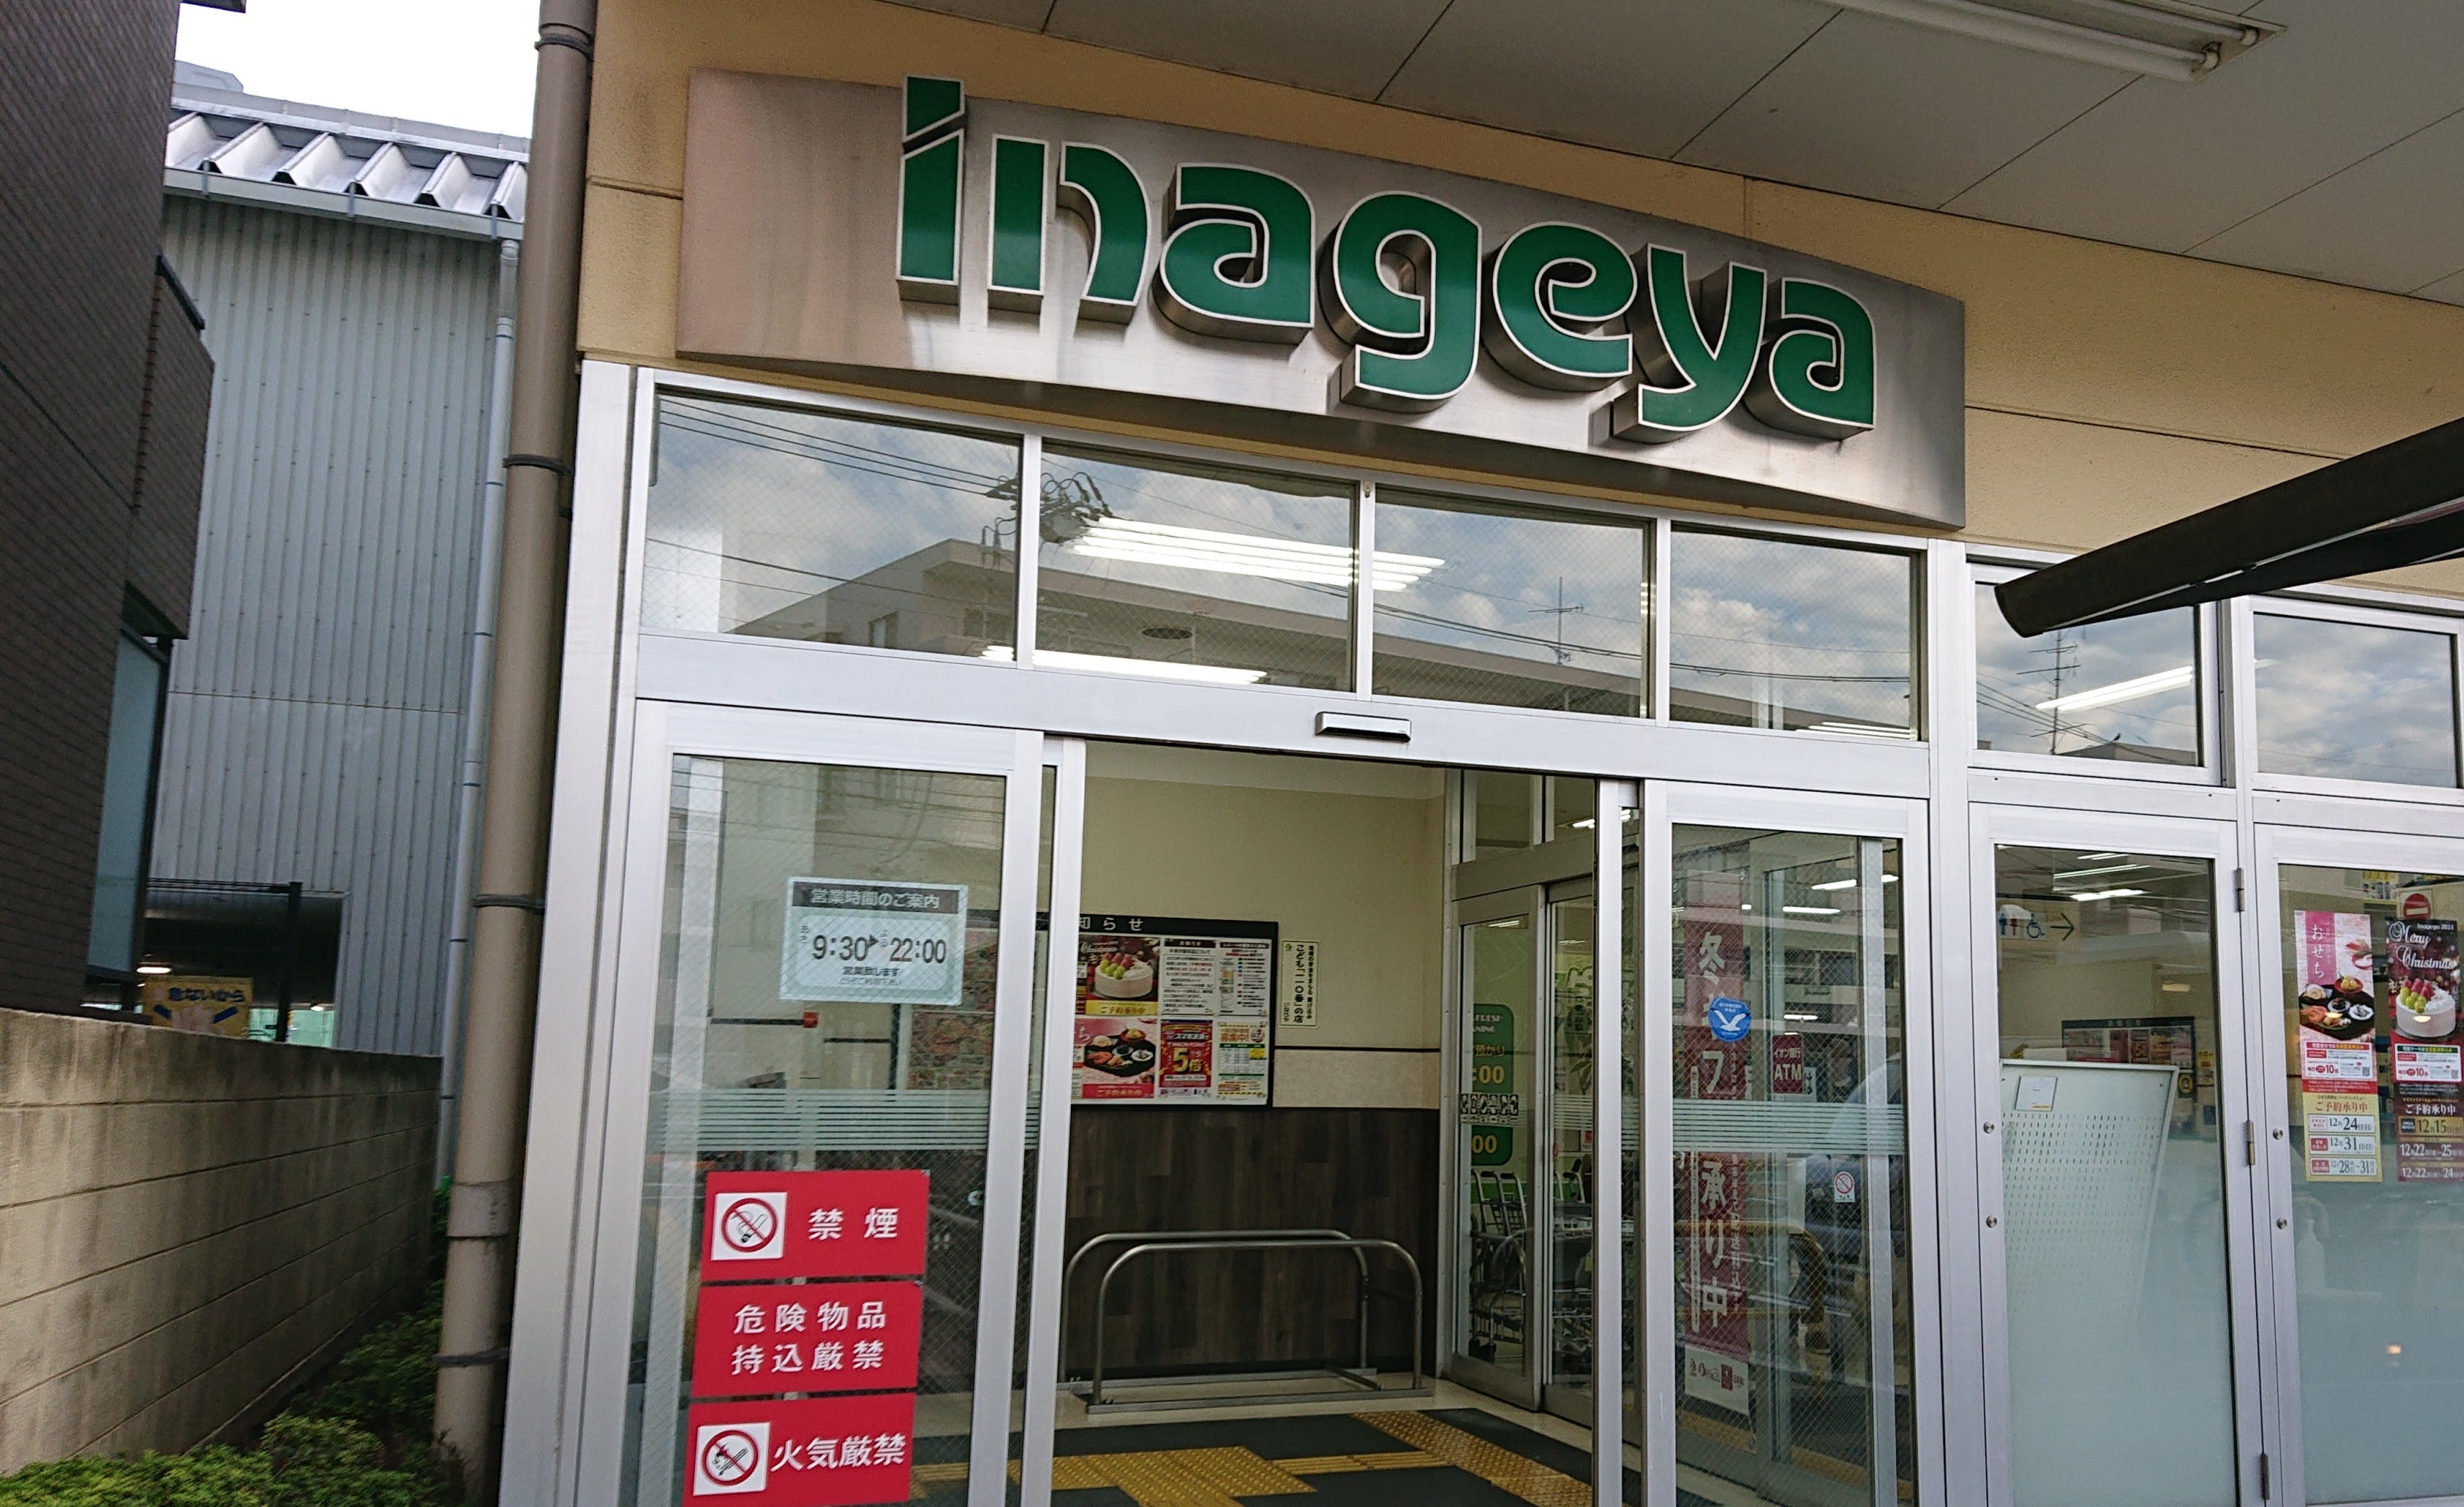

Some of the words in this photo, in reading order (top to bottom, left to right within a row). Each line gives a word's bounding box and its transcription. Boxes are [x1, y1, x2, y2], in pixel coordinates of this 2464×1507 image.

[896, 75, 1875, 442] inageya
[811, 888, 939, 909] 営業時間のご案内
[812, 934, 869, 961] 9:30
[2388, 921, 2432, 949] Merry
[890, 937, 947, 964] 22:00
[2311, 924, 2324, 979] おせち
[2396, 944, 2455, 970] Christmas
[1172, 1047, 1203, 1073] 5倍
[1774, 1063, 1802, 1080] ATM
[2315, 1101, 2368, 1113] ご予約承り中
[2405, 1103, 2456, 1116] ご予約承り中
[808, 1207, 898, 1241] 禁煙
[733, 1301, 887, 1334] 危険物品
[731, 1341, 884, 1376] 持込厳禁
[770, 1433, 906, 1472] 火気厳禁
